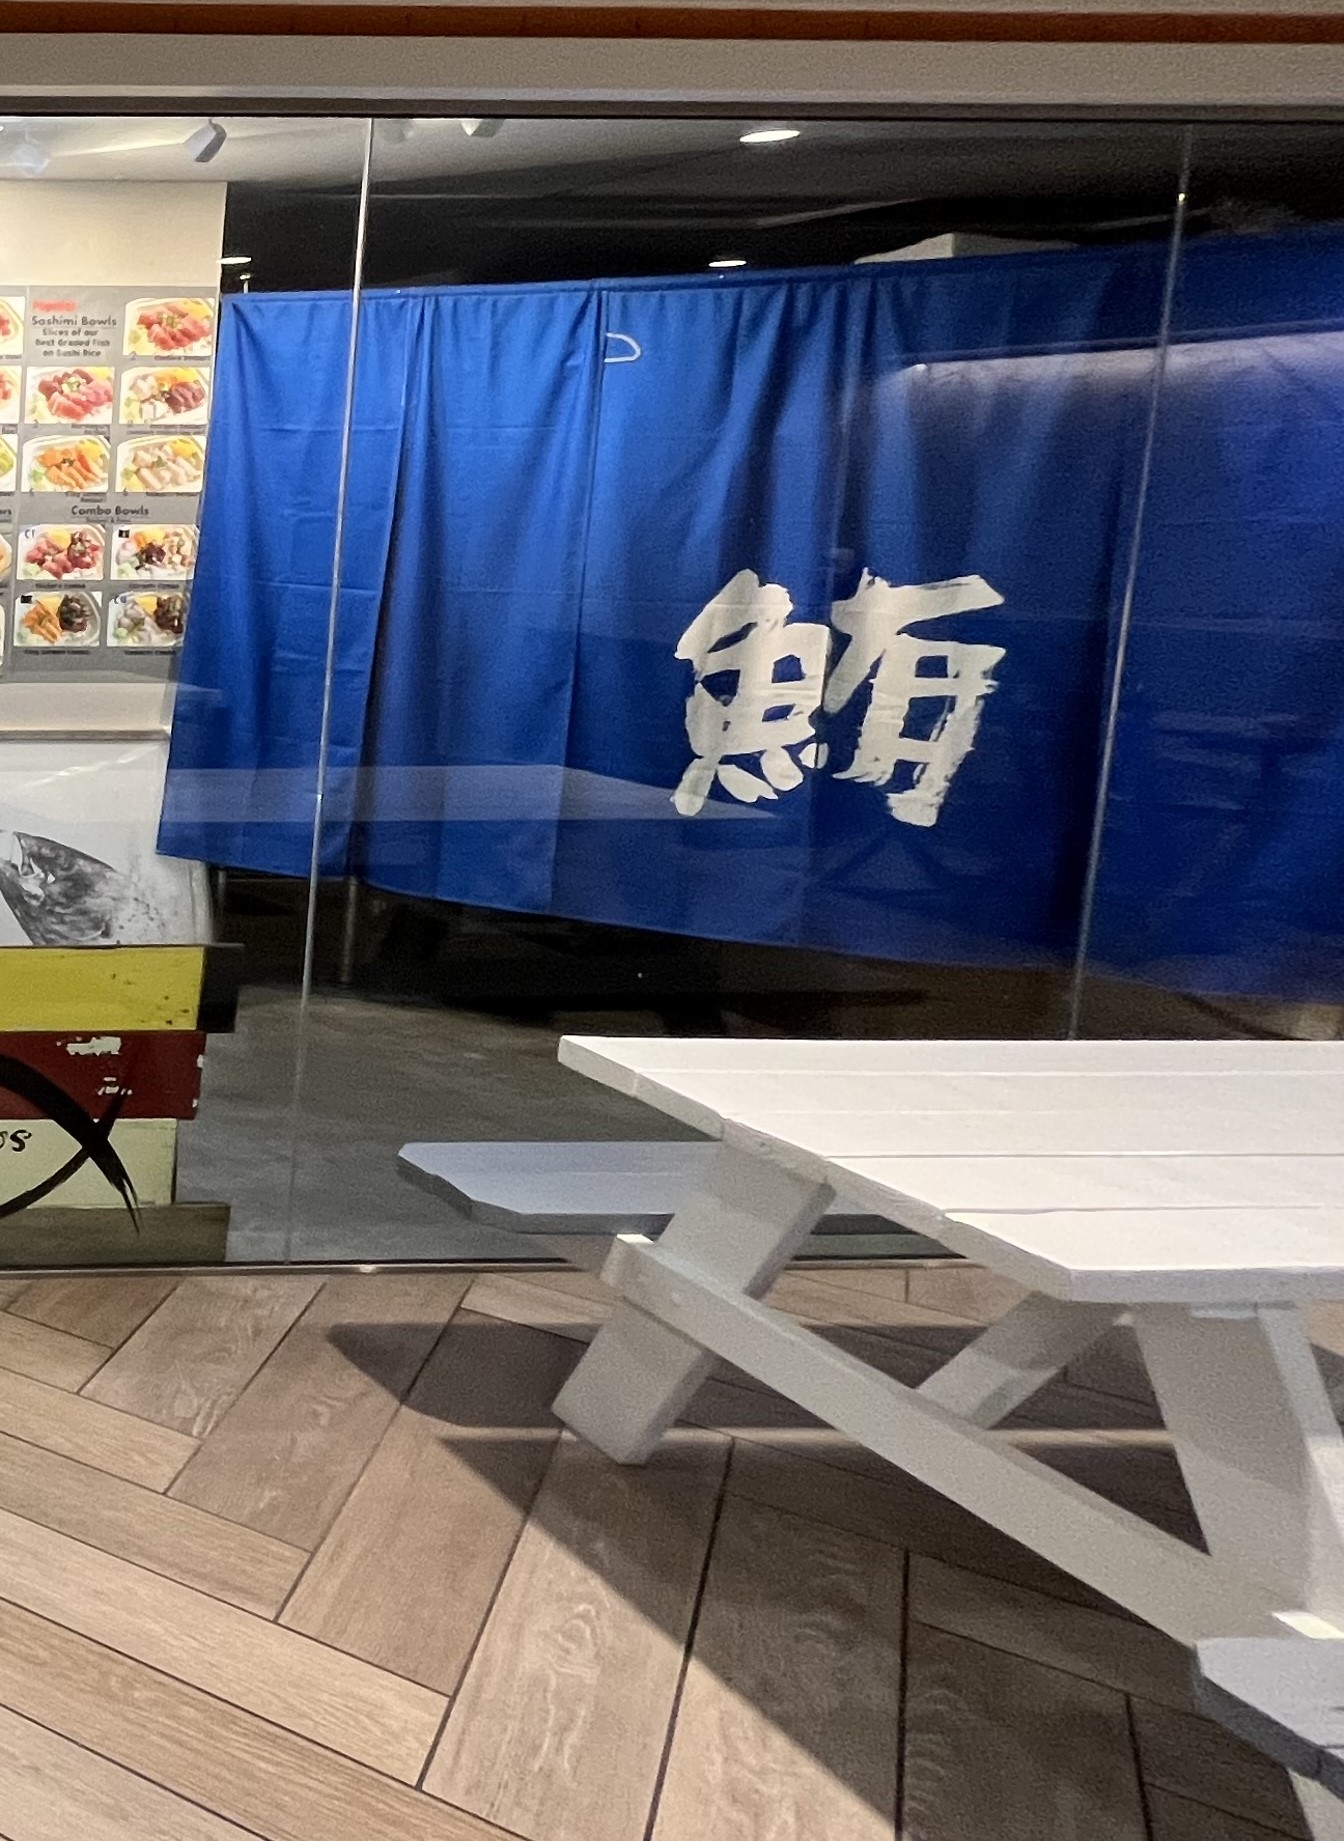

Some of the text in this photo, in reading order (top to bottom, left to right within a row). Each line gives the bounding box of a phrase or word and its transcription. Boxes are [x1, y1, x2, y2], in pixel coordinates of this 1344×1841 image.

[31, 315, 117, 327] Sashimi Bowls
[71, 505, 150, 516] Combo Bowls
[668, 566, 1007, 827] 鮪
